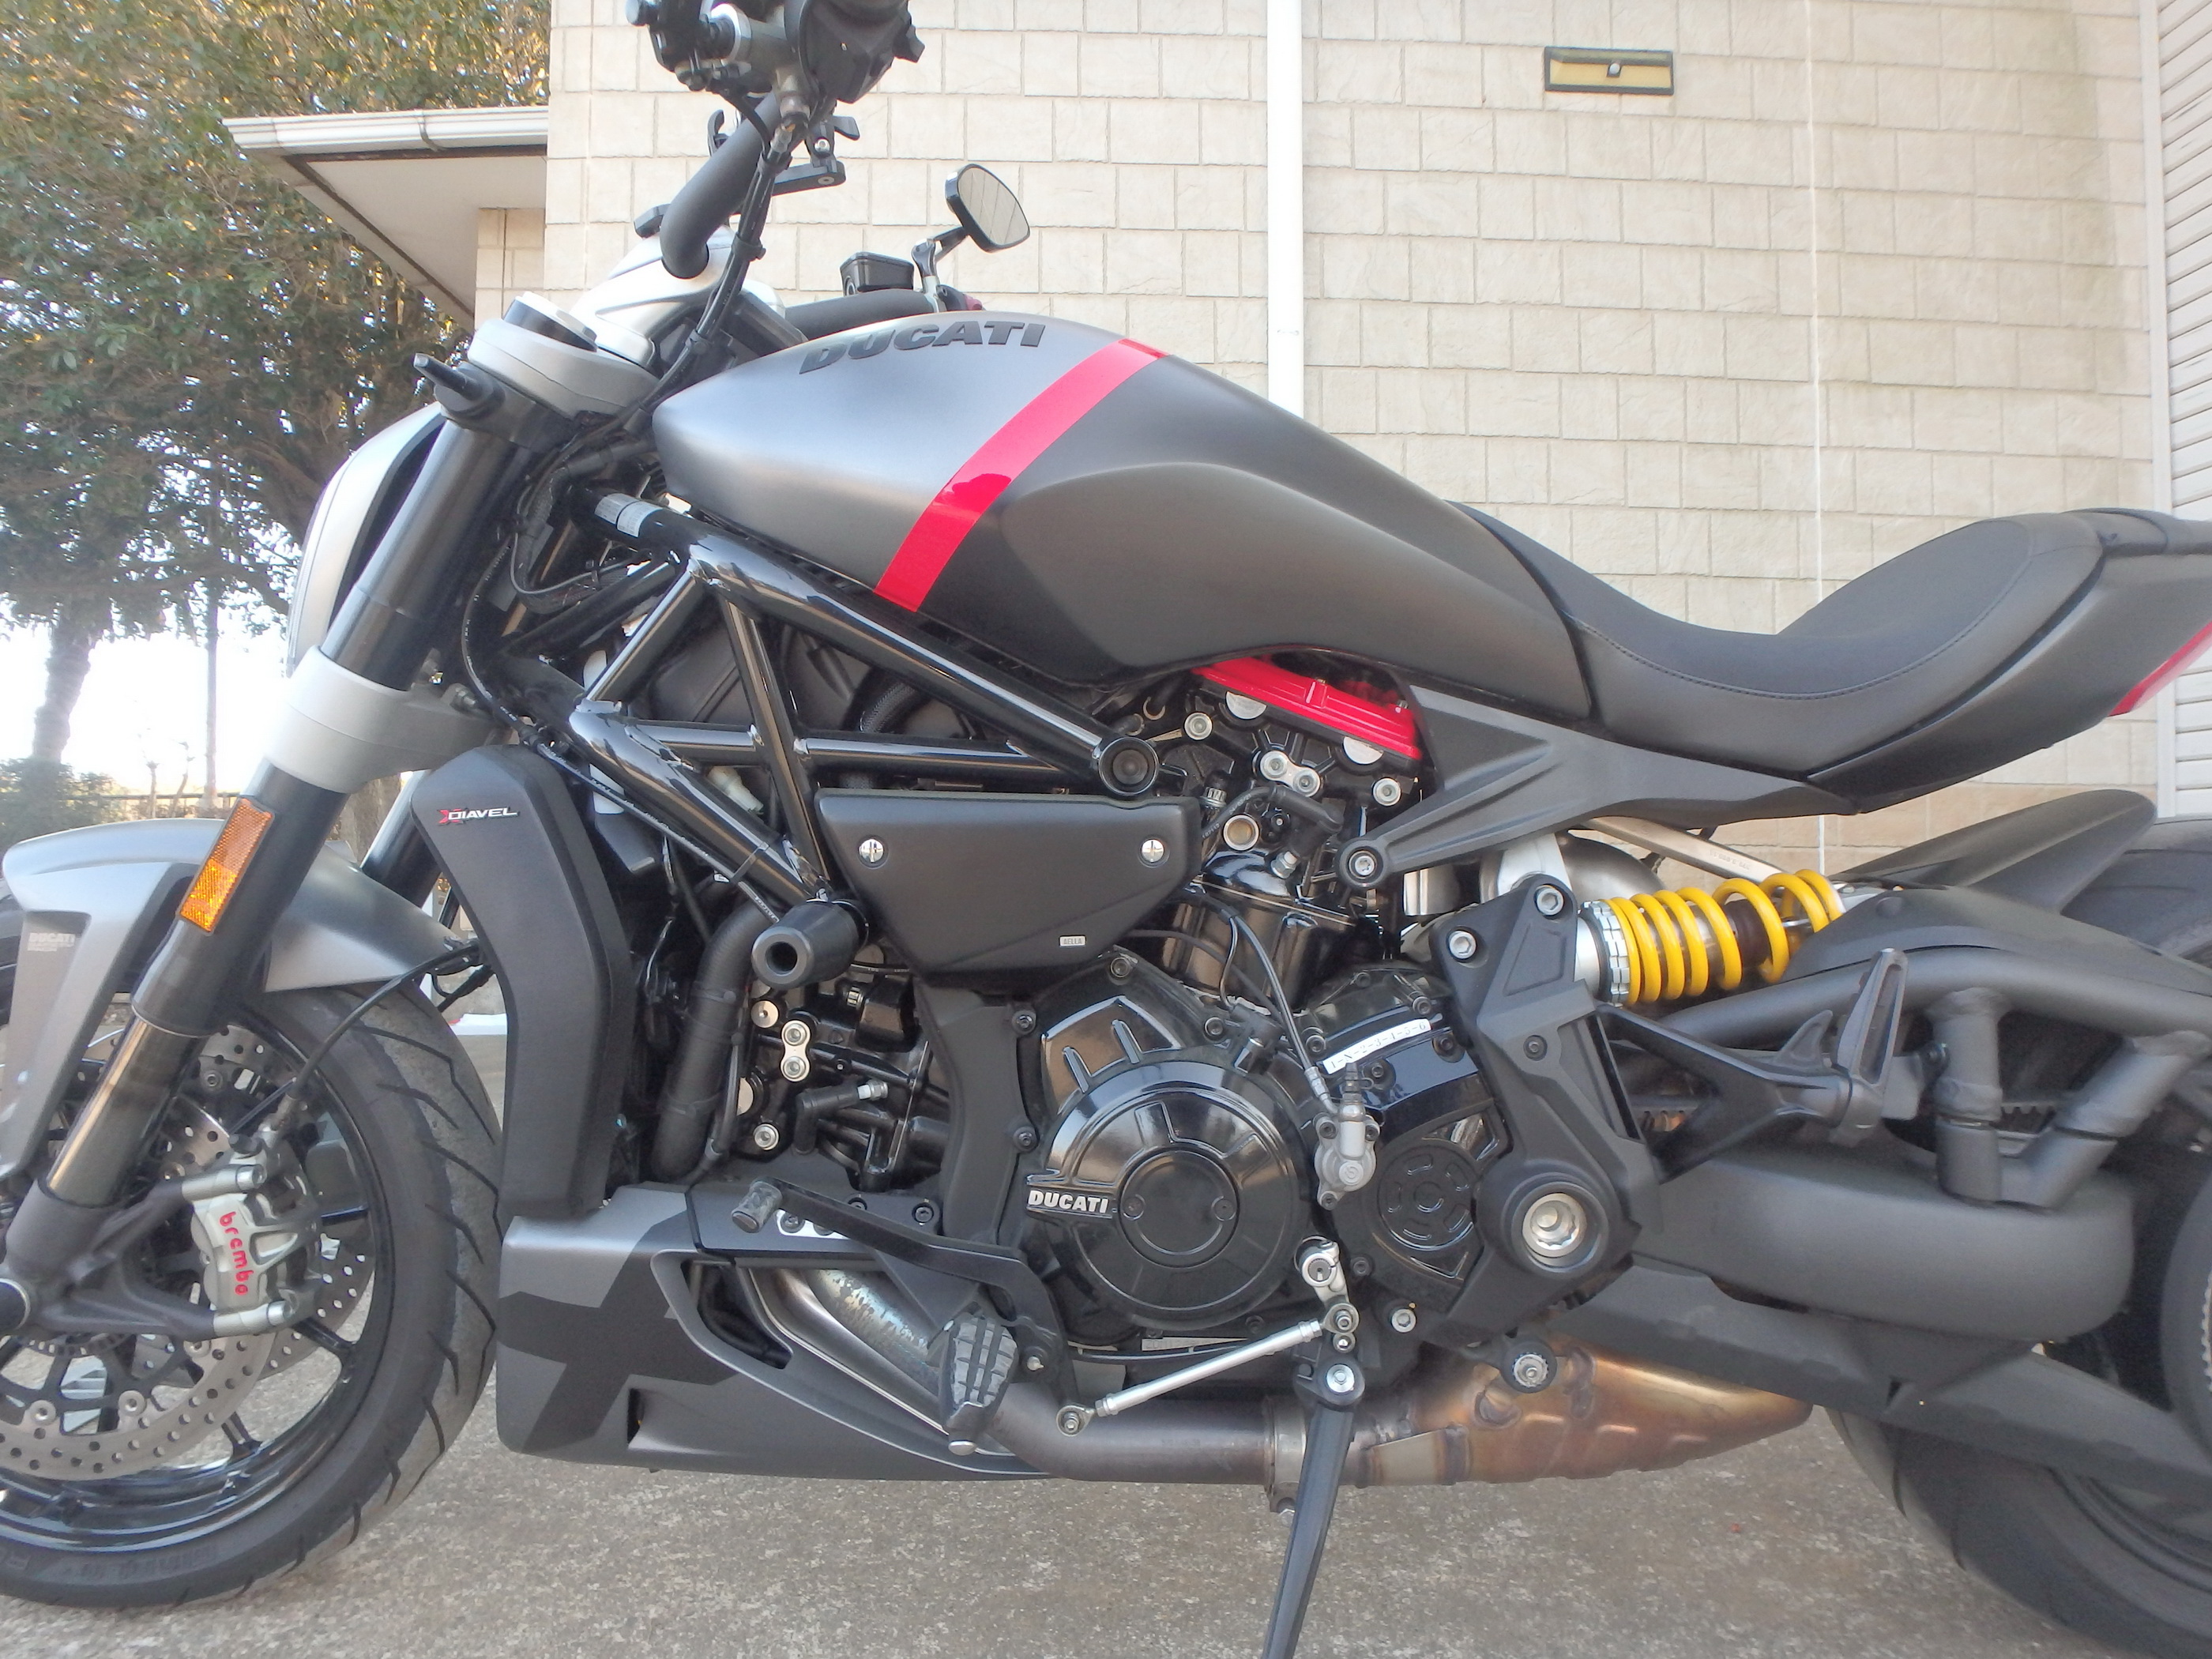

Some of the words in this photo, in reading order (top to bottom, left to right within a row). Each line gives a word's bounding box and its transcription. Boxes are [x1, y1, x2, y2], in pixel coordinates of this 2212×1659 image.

[799, 321, 1045, 374] DUCATI
[438, 808, 518, 824] XDIAVEL
[28, 933, 75, 943] DUCATI
[1028, 1190, 1109, 1213] DUCATI
[220, 1211, 254, 1296] brembo
